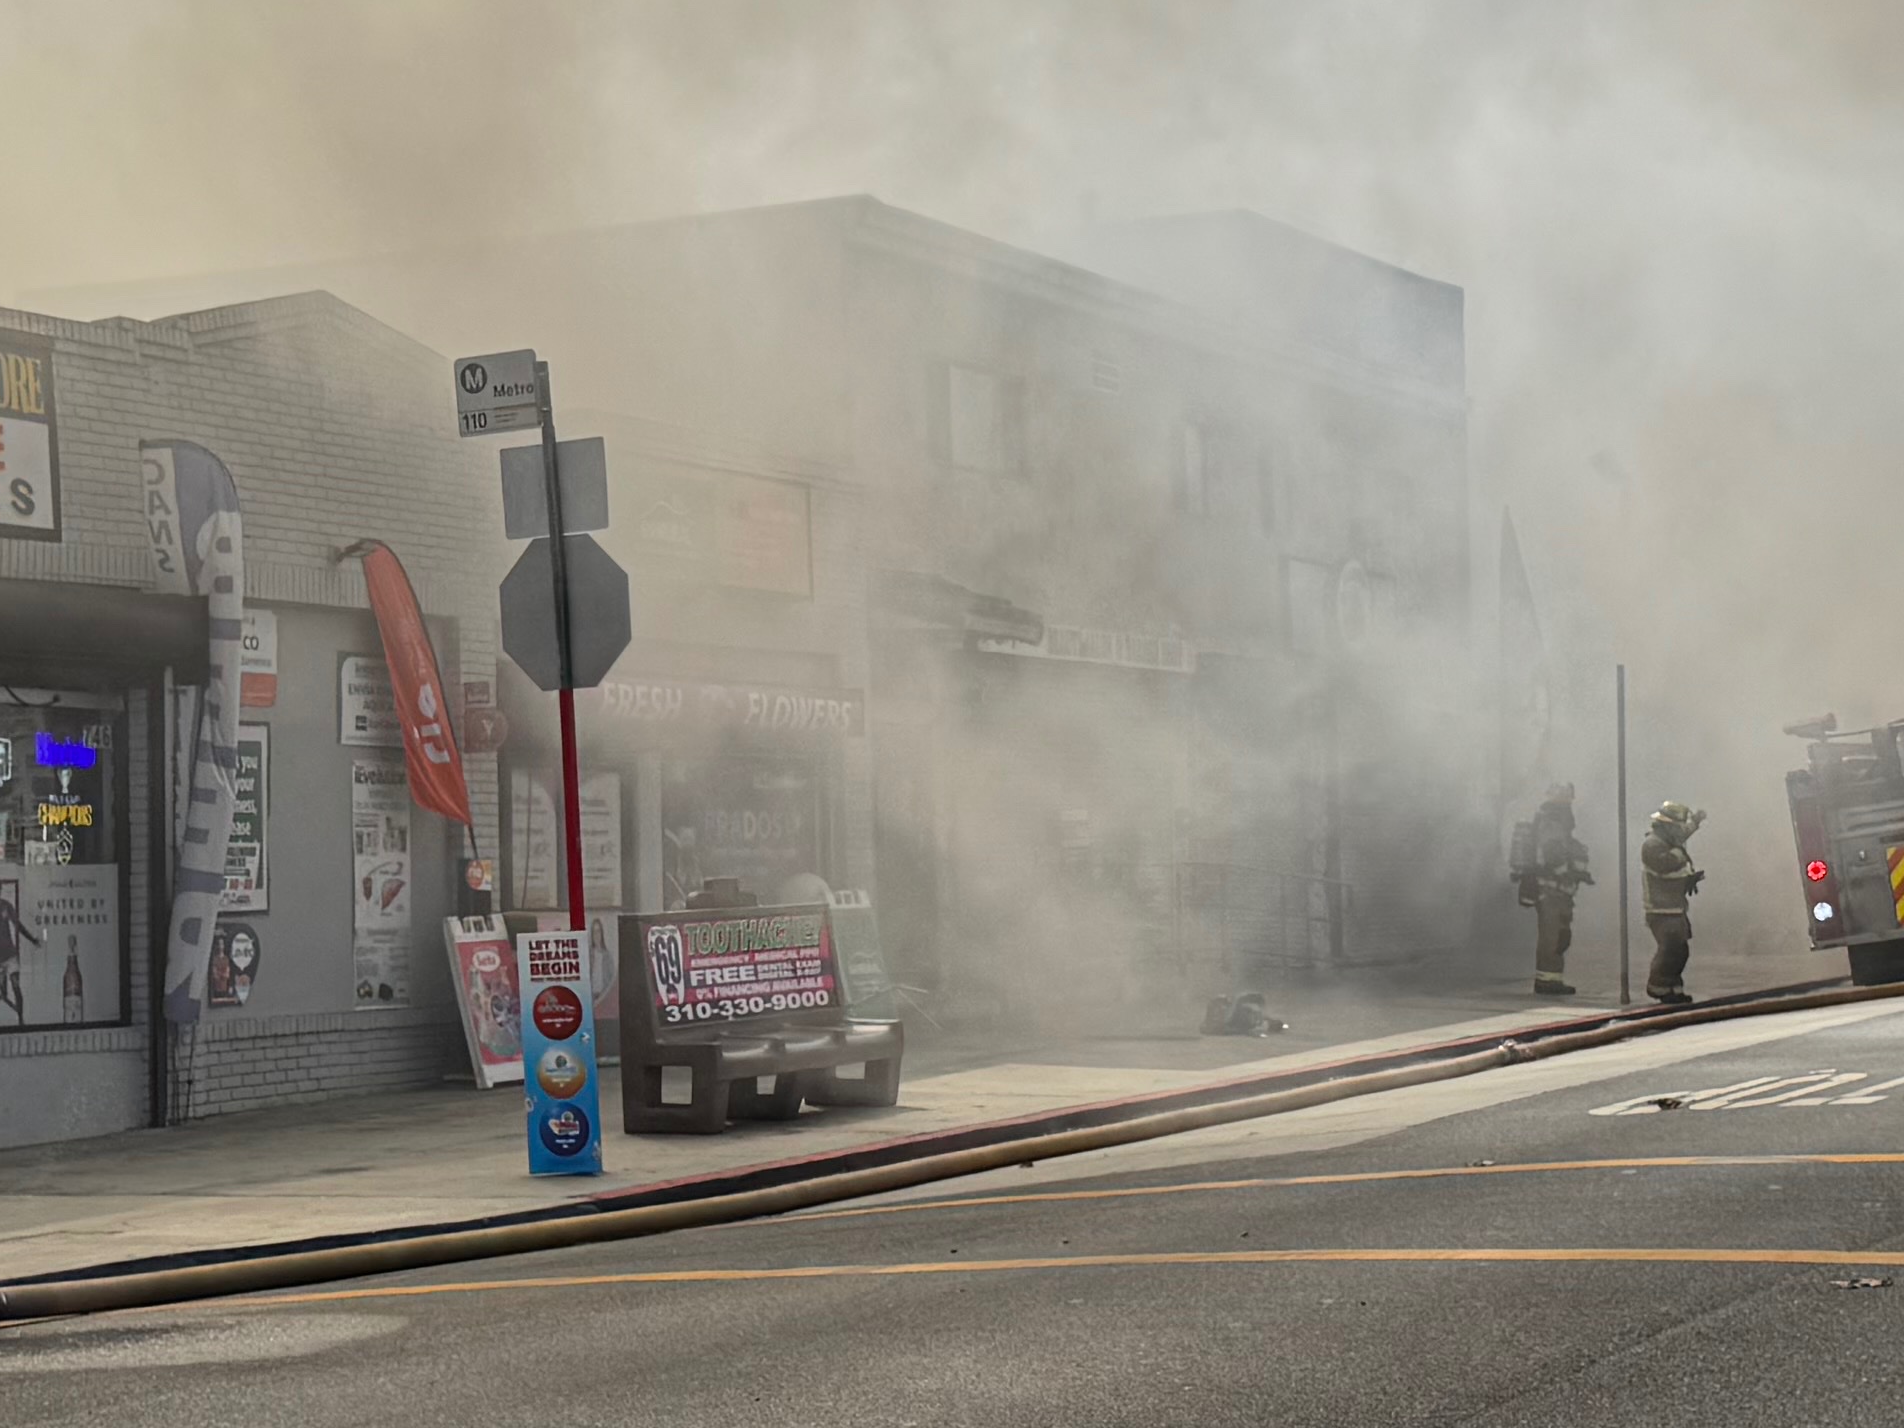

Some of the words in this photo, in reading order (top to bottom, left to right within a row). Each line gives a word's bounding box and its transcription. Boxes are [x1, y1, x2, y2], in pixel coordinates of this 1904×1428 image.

[492, 383, 534, 397] Metro
[463, 412, 487, 433] 110
[602, 682, 682, 719] FRESH
[745, 692, 851, 730] FLOWERS
[529, 940, 550, 950] LET
[554, 939, 578, 949] THE
[529, 951, 580, 962] DREAMS
[530, 961, 581, 976] BEGIN
[690, 966, 756, 987] FREE
[665, 990, 830, 1022] 310-330-9000
